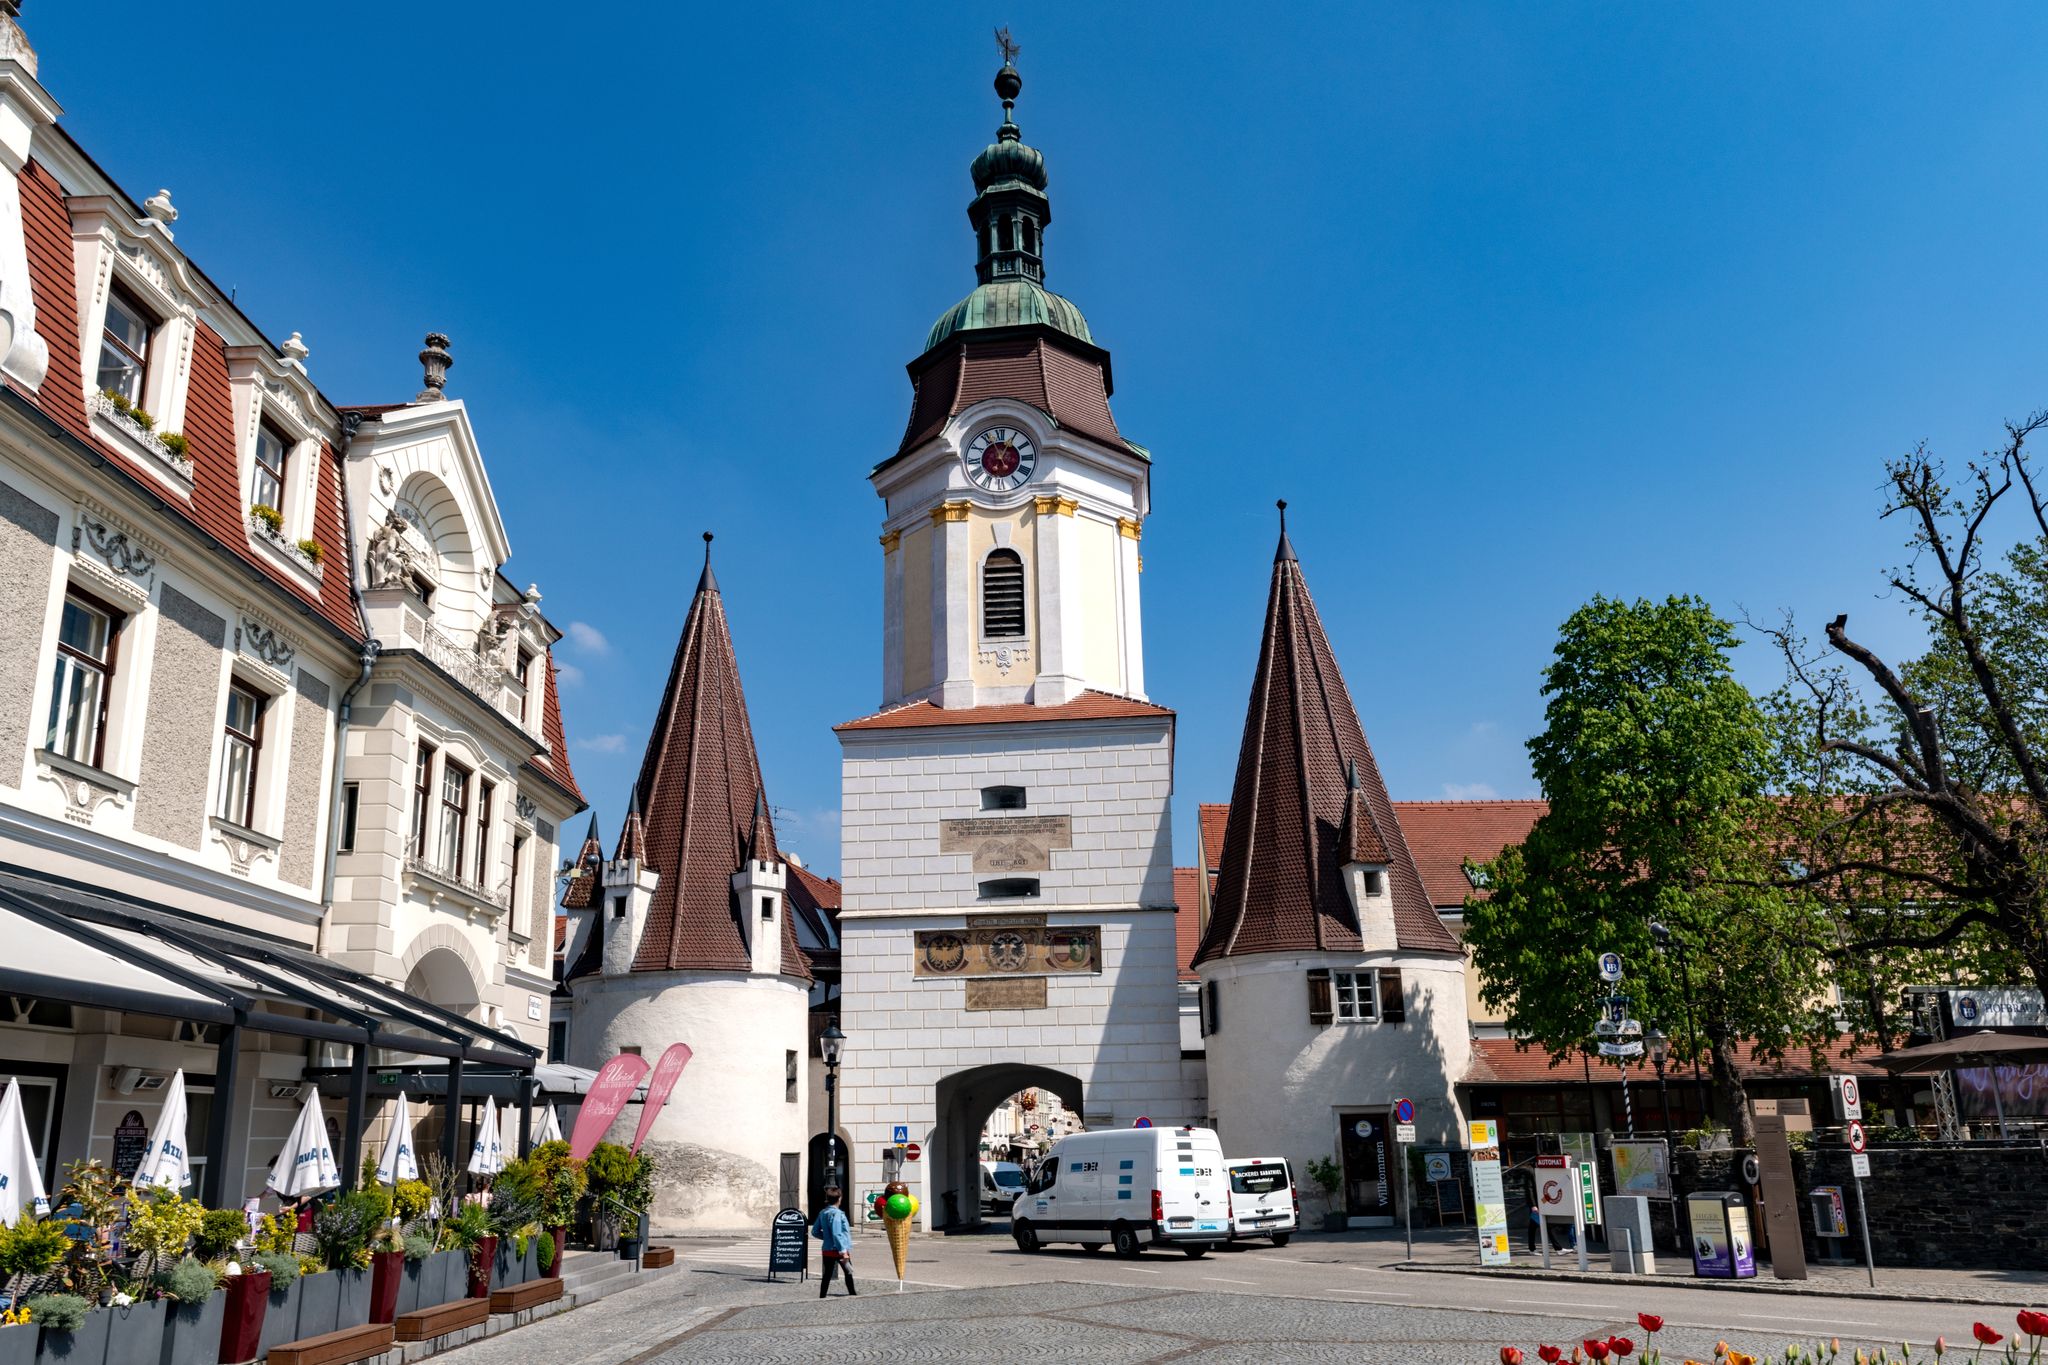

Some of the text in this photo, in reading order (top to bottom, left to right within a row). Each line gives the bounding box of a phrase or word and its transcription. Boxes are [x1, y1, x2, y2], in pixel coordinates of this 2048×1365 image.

[1606, 963, 1617, 972] HB
[1963, 1007, 1975, 1018] HB
[606, 1063, 637, 1082] Ulrich
[1846, 1086, 1855, 1098] 30
[1847, 1107, 1860, 1117] Zone
[1377, 1141, 1388, 1207] Willkommen
